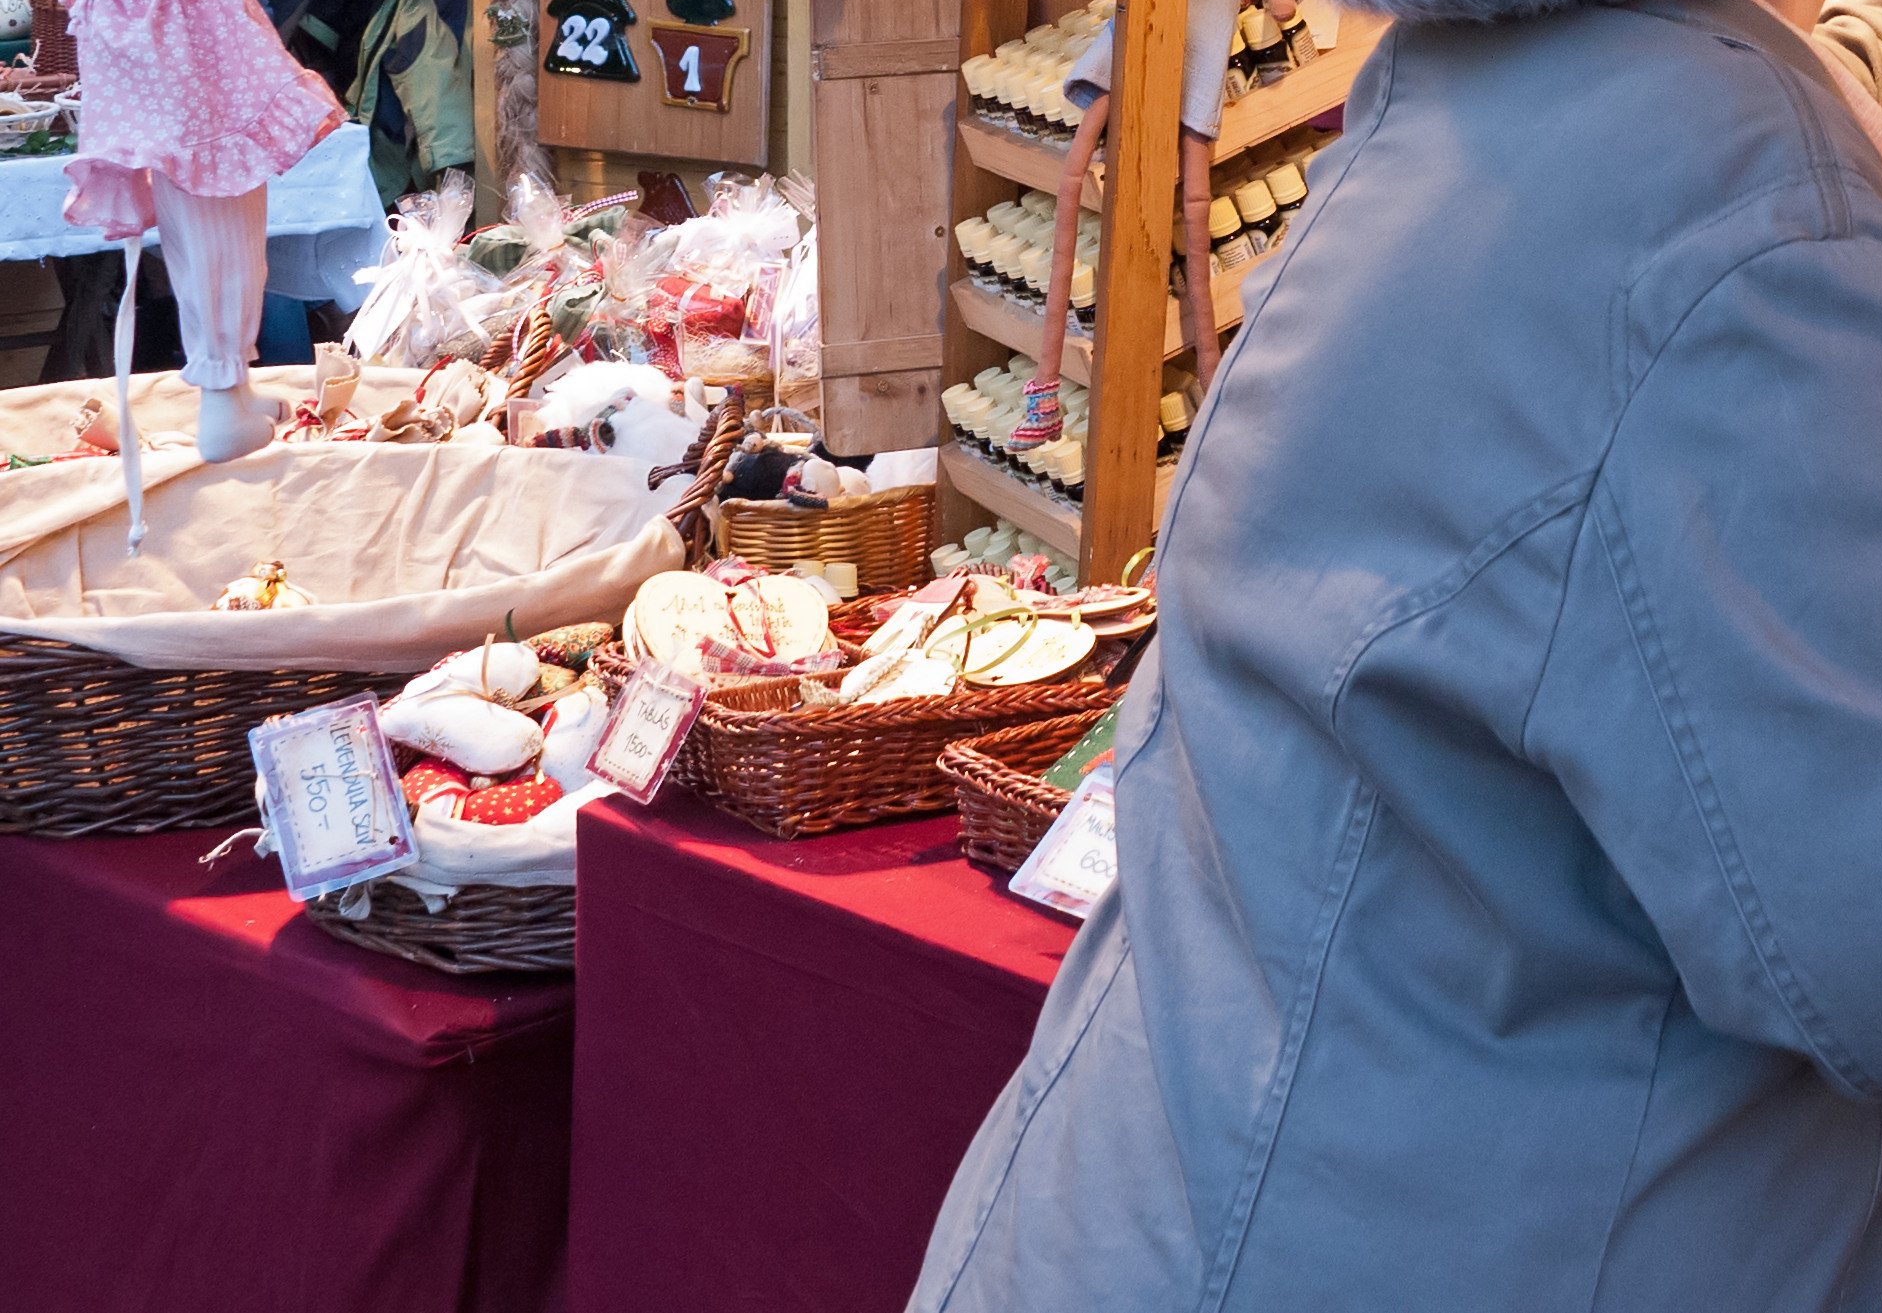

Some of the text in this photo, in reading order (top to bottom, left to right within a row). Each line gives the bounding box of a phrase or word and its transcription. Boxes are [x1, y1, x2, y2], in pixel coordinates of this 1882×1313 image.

[557, 14, 611, 66] 22
[678, 45, 701, 92] 1
[329, 724, 369, 814] LEVENDULA
